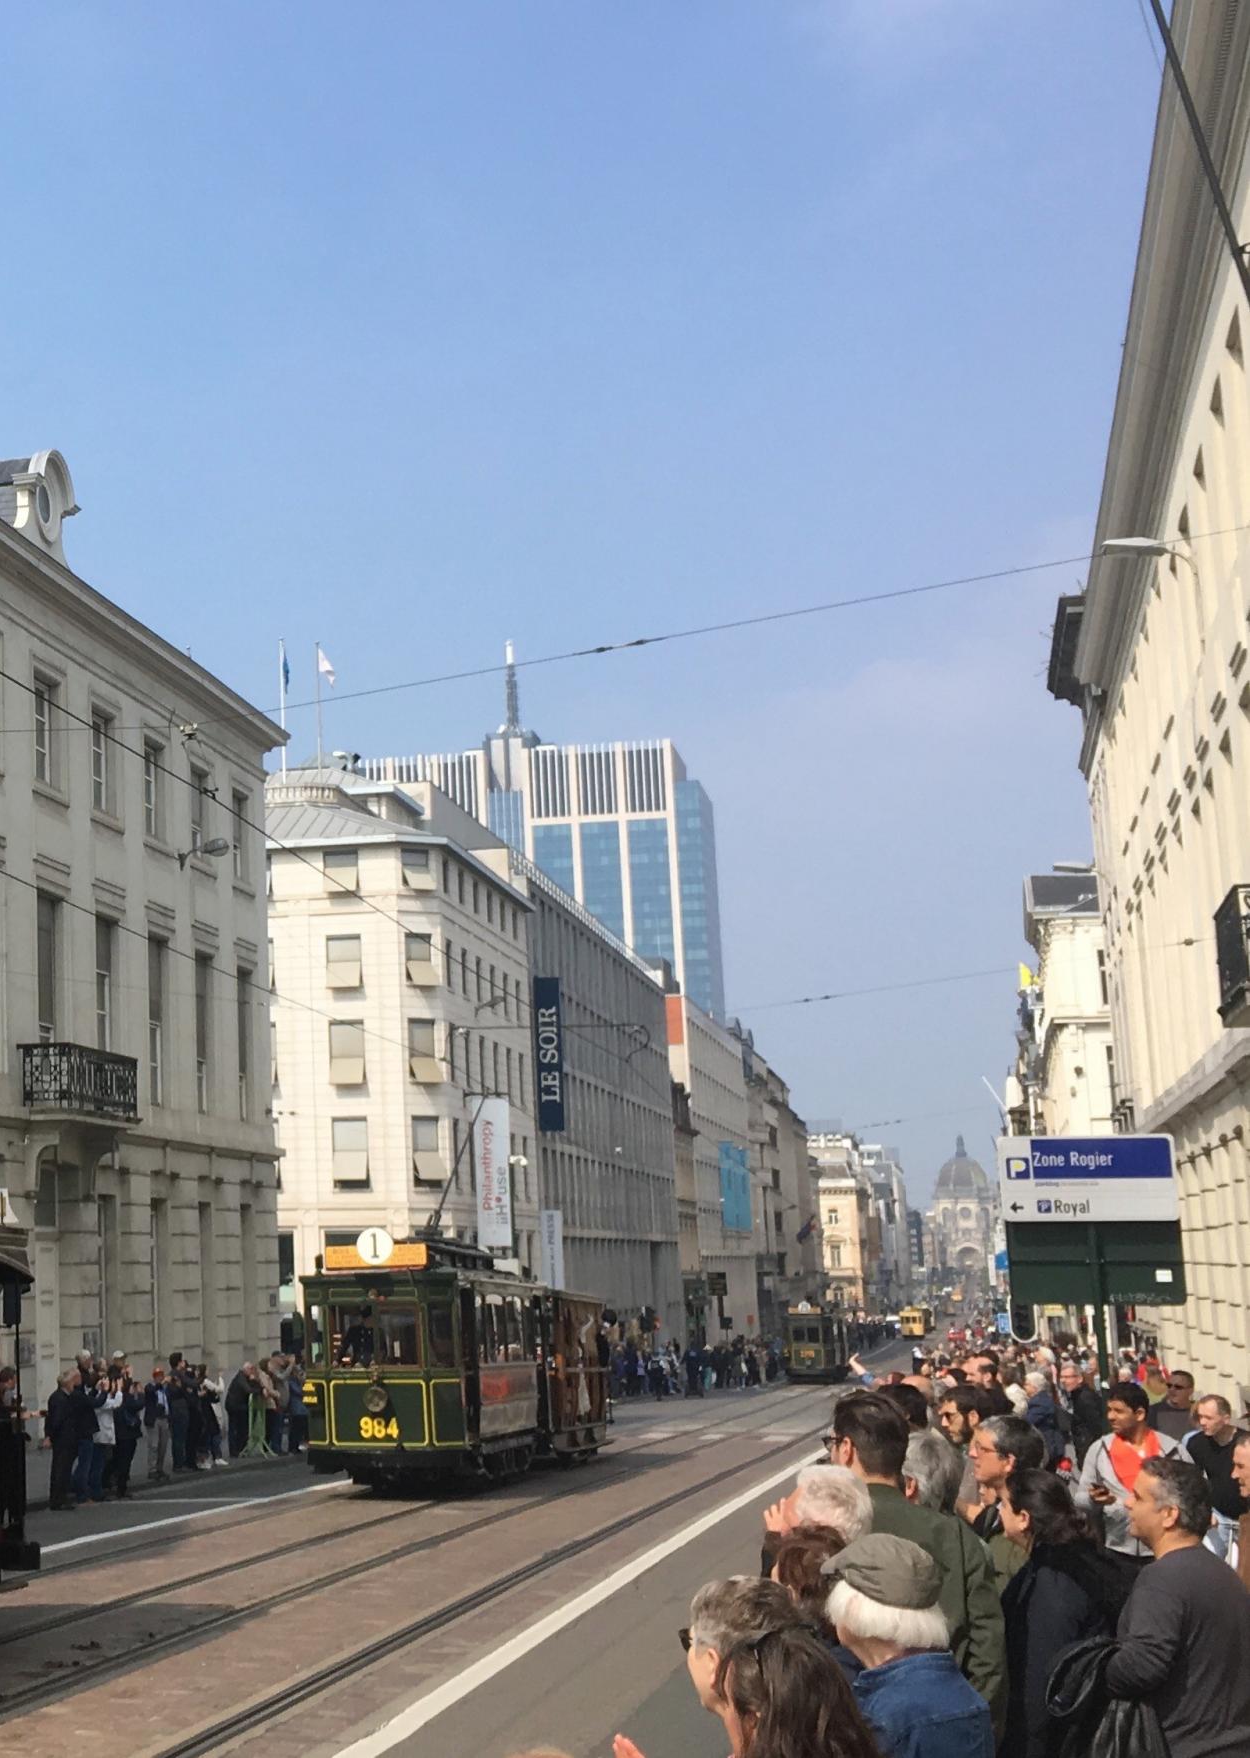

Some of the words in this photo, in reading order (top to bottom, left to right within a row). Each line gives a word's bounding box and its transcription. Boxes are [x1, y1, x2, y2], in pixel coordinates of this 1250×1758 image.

[538, 1006, 559, 1064] SOIR
[541, 1071, 560, 1103] LE
[481, 1119, 494, 1211] Philanthropy
[1032, 1151, 1065, 1167] Zone
[1069, 1150, 1114, 1170] Rogier
[1054, 1199, 1091, 1217] Royal
[370, 1232, 380, 1259] 1
[359, 1416, 399, 1439] 984
